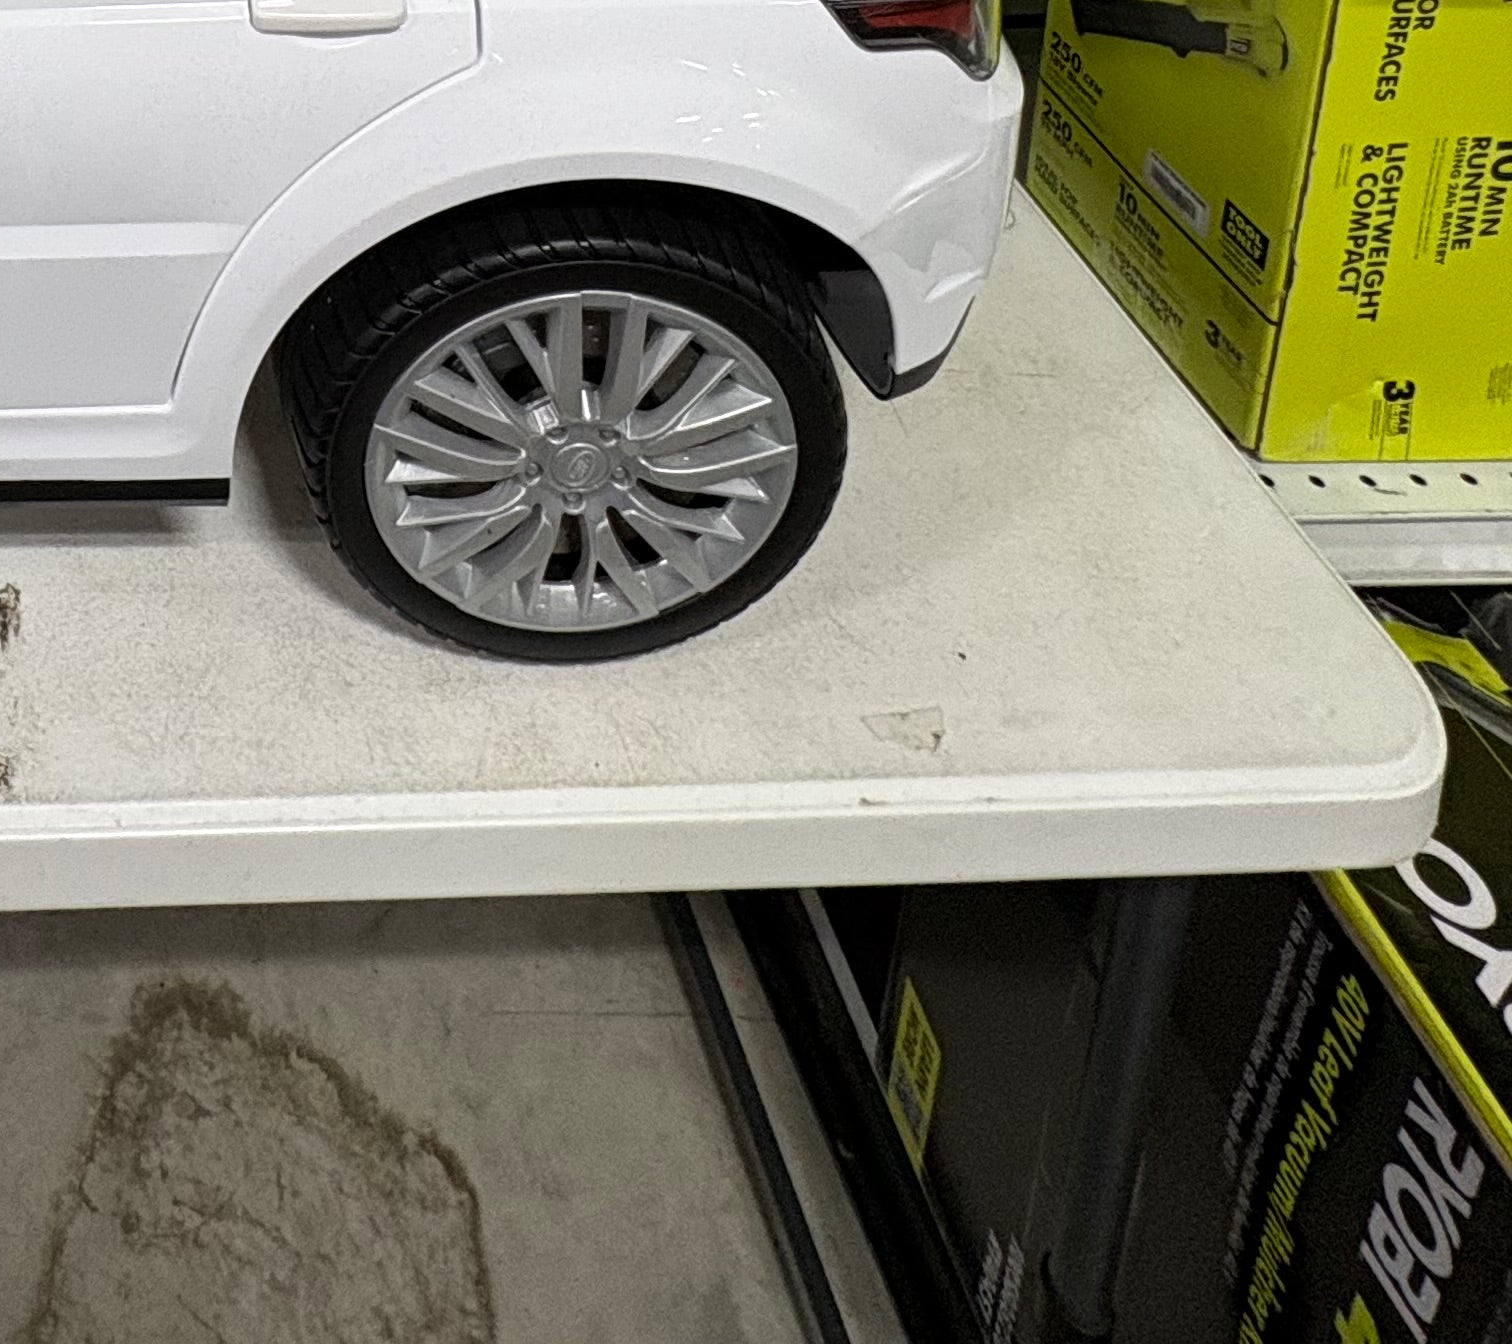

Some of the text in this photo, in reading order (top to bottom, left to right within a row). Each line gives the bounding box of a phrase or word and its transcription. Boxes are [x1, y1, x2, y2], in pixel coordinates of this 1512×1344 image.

[1051, 31, 1083, 74] 250
[1043, 99, 1073, 143] 250
[1360, 143, 1385, 164] &
[1118, 182, 1138, 215] 10
[1434, 136, 1470, 266] USING 2Ah BATTERY
[1450, 136, 1493, 252] RUNTIME
[1478, 184, 1508, 238] MIN
[1226, 221, 1263, 260] ONLY
[1228, 205, 1263, 247] TOOL
[1338, 172, 1380, 297] COMPACT
[1356, 142, 1409, 323] LIGHTWEIGHT
[1205, 319, 1222, 350] 3
[1382, 378, 1416, 436] 3 YEAR
[1331, 974, 1371, 1058] 40V
[1309, 1026, 1354, 1126] Leaf
[1247, 1099, 1332, 1332] Vacuum/Mulcher
[1359, 1077, 1486, 1343] RYOBI
